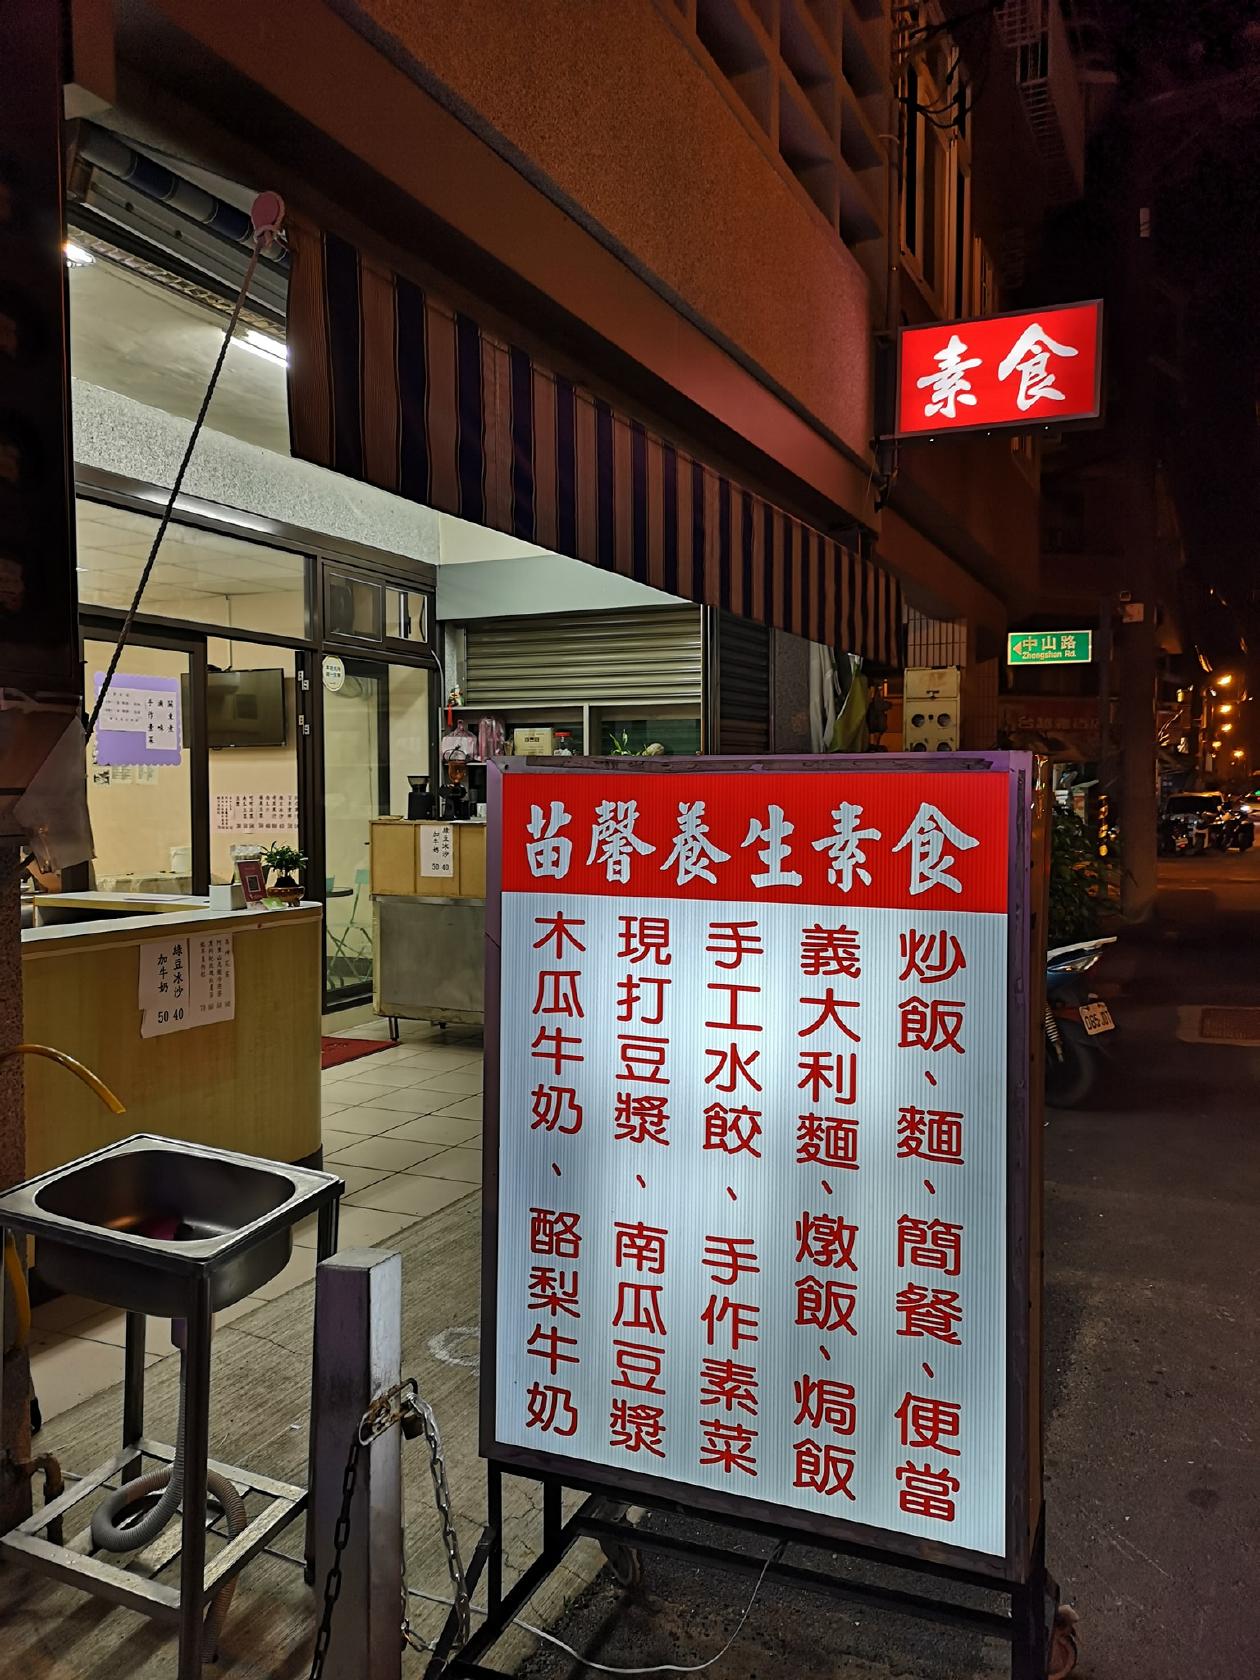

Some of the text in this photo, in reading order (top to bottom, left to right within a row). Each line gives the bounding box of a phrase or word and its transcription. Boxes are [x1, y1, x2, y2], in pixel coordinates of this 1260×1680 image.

[917, 322, 1079, 419] 素食
[1022, 635, 1076, 651] 中山路
[525, 799, 980, 896] 苗馨養生素食
[157, 953, 168, 993] 加牛奶
[157, 1010, 169, 1023] 50
[172, 944, 184, 998] 綠豆冰沙
[173, 1007, 184, 1020] 40
[528, 911, 585, 1436] 木瓜牛奶、酪梨牛奶
[610, 915, 672, 1457] 現打豆漿、南瓜豆漿
[699, 920, 763, 1476] 手工水餃、手作素菜
[794, 923, 862, 1500] 義大利麵、燉飯、焗飯
[895, 927, 967, 1522] 炒飯、麵、簡餐、便當
